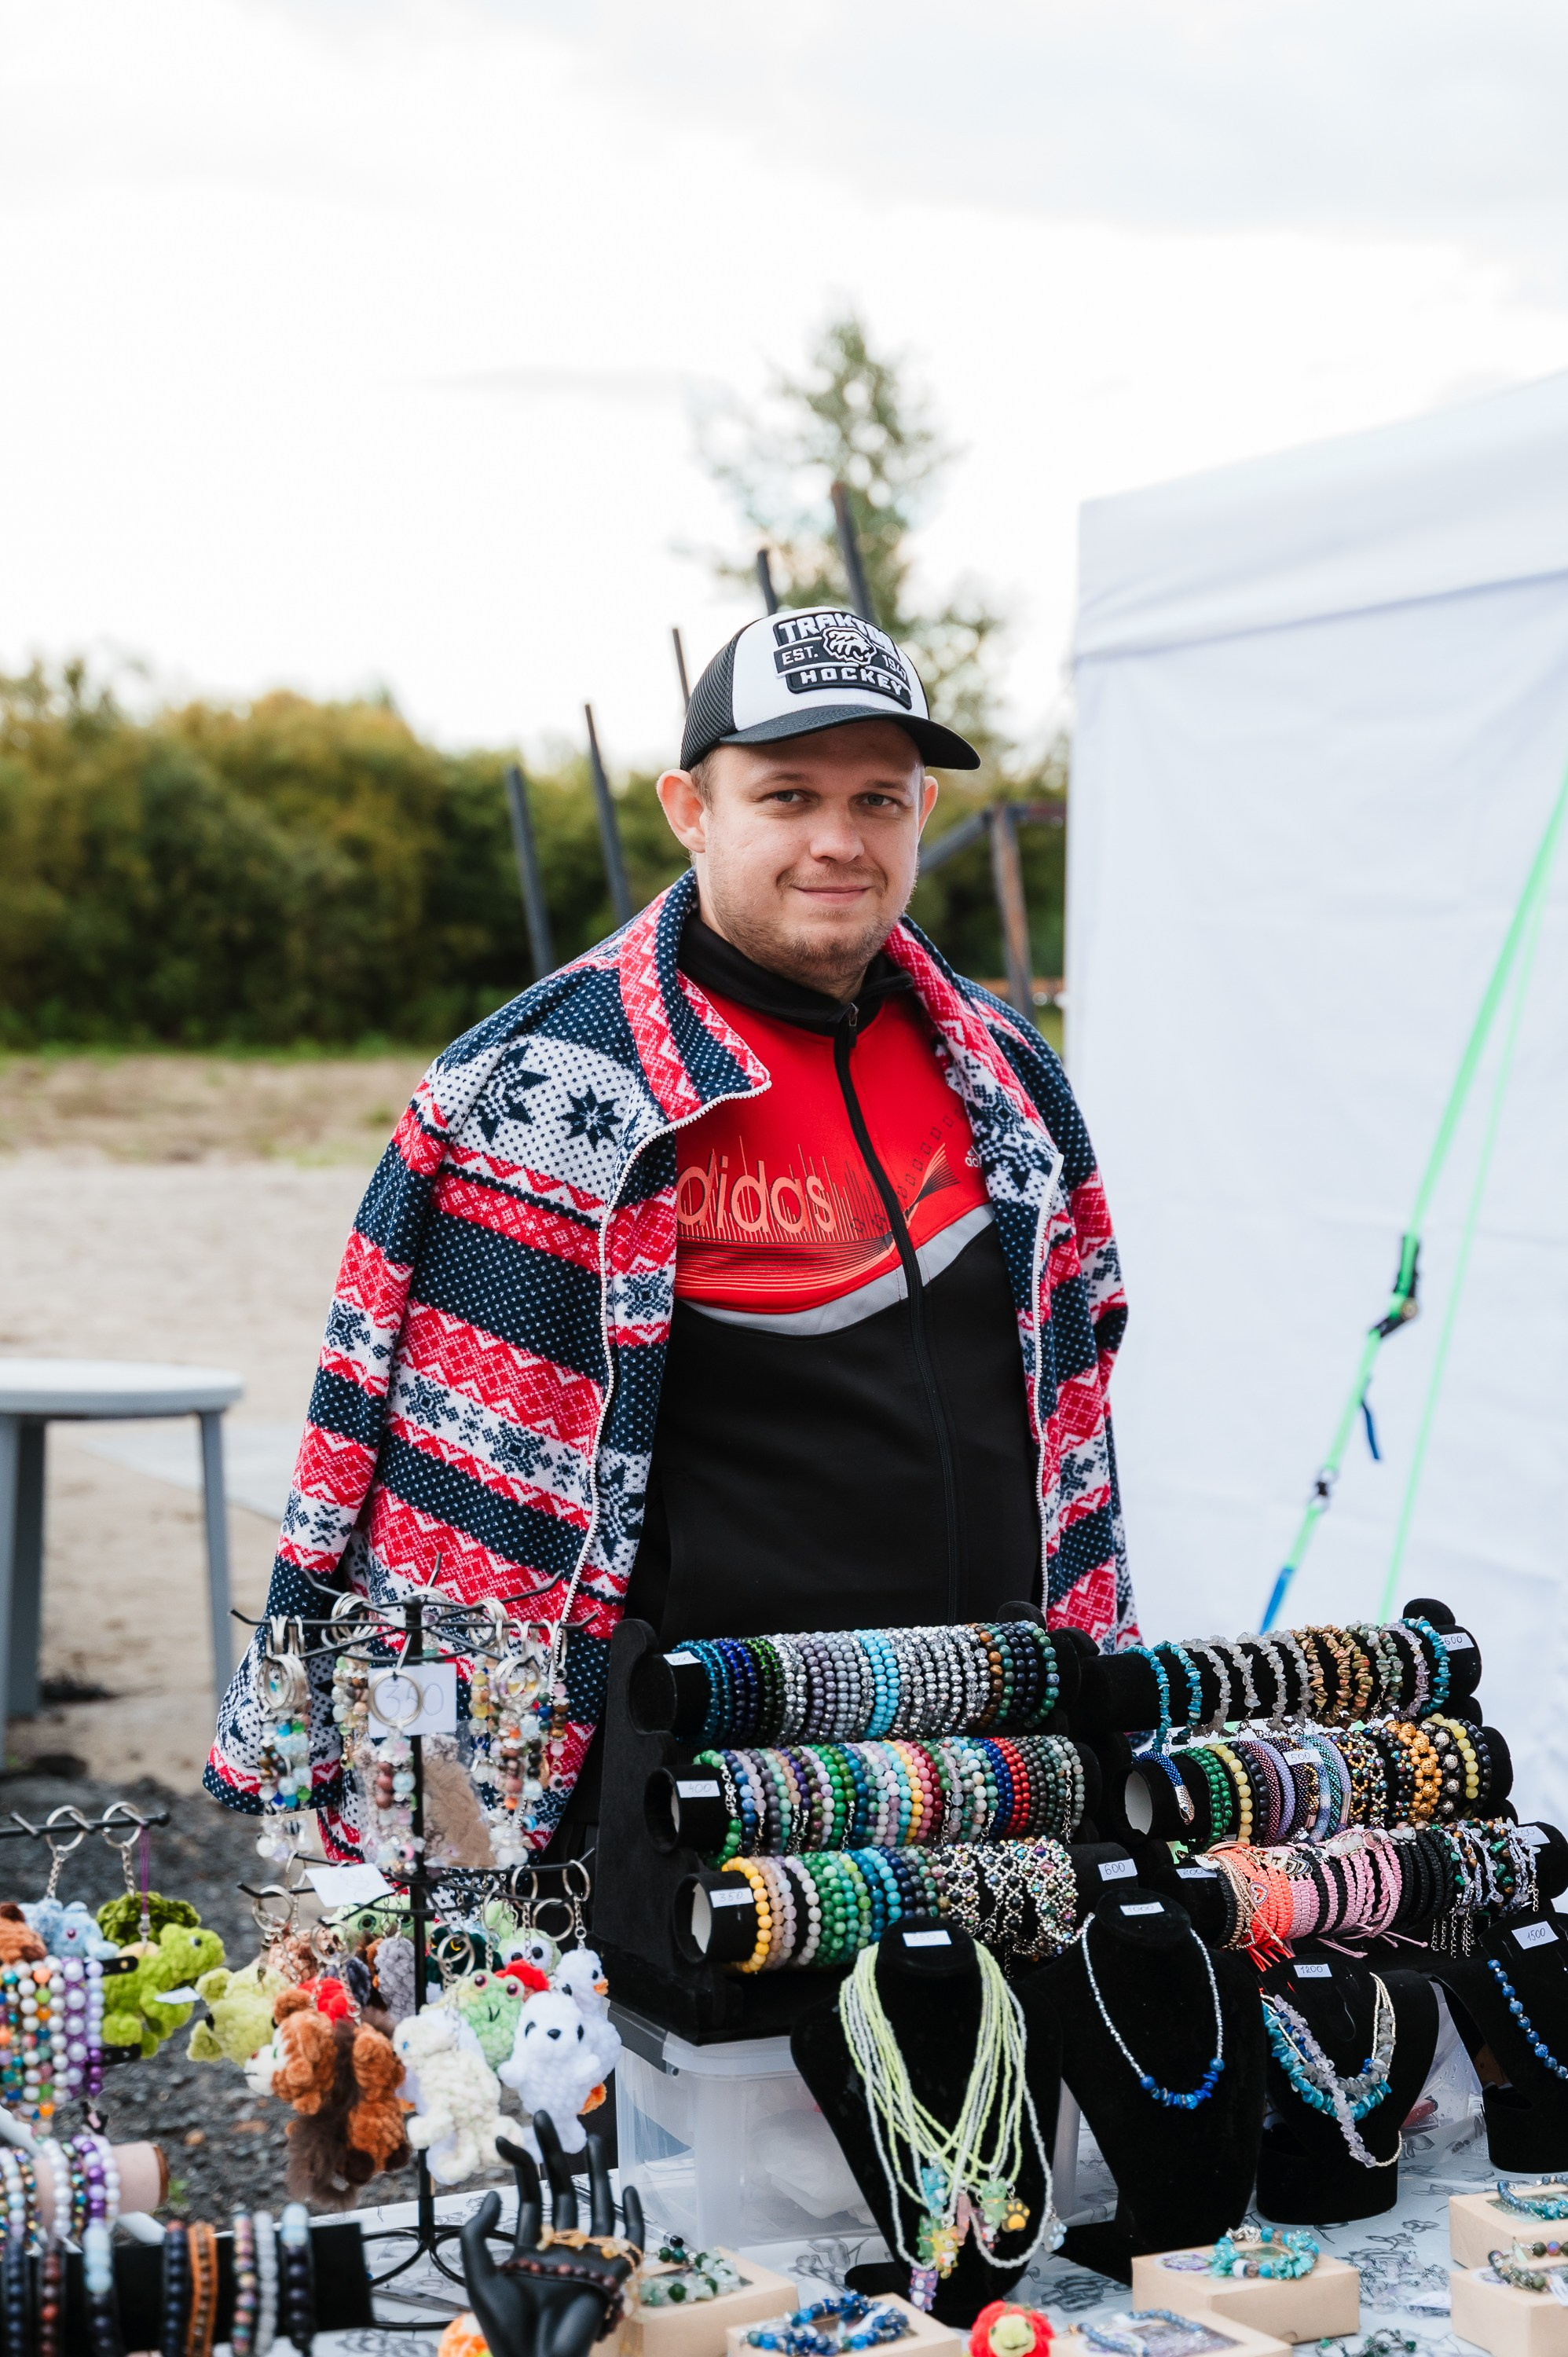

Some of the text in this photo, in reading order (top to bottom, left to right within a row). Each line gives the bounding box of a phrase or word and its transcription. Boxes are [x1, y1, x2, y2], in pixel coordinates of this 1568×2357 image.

[782, 645, 819, 665] EST.
[800, 667, 903, 696] HOCKEY
[676, 1152, 836, 1233] didas
[1444, 1636, 1463, 1645] 600
[1291, 1751, 1311, 1762] 500
[688, 1783, 712, 1794] 400
[1105, 1862, 1126, 1875] 600
[718, 1891, 743, 1902] 350
[1527, 1927, 1546, 1941] 1500
[1300, 1965, 1323, 1974] 1200
